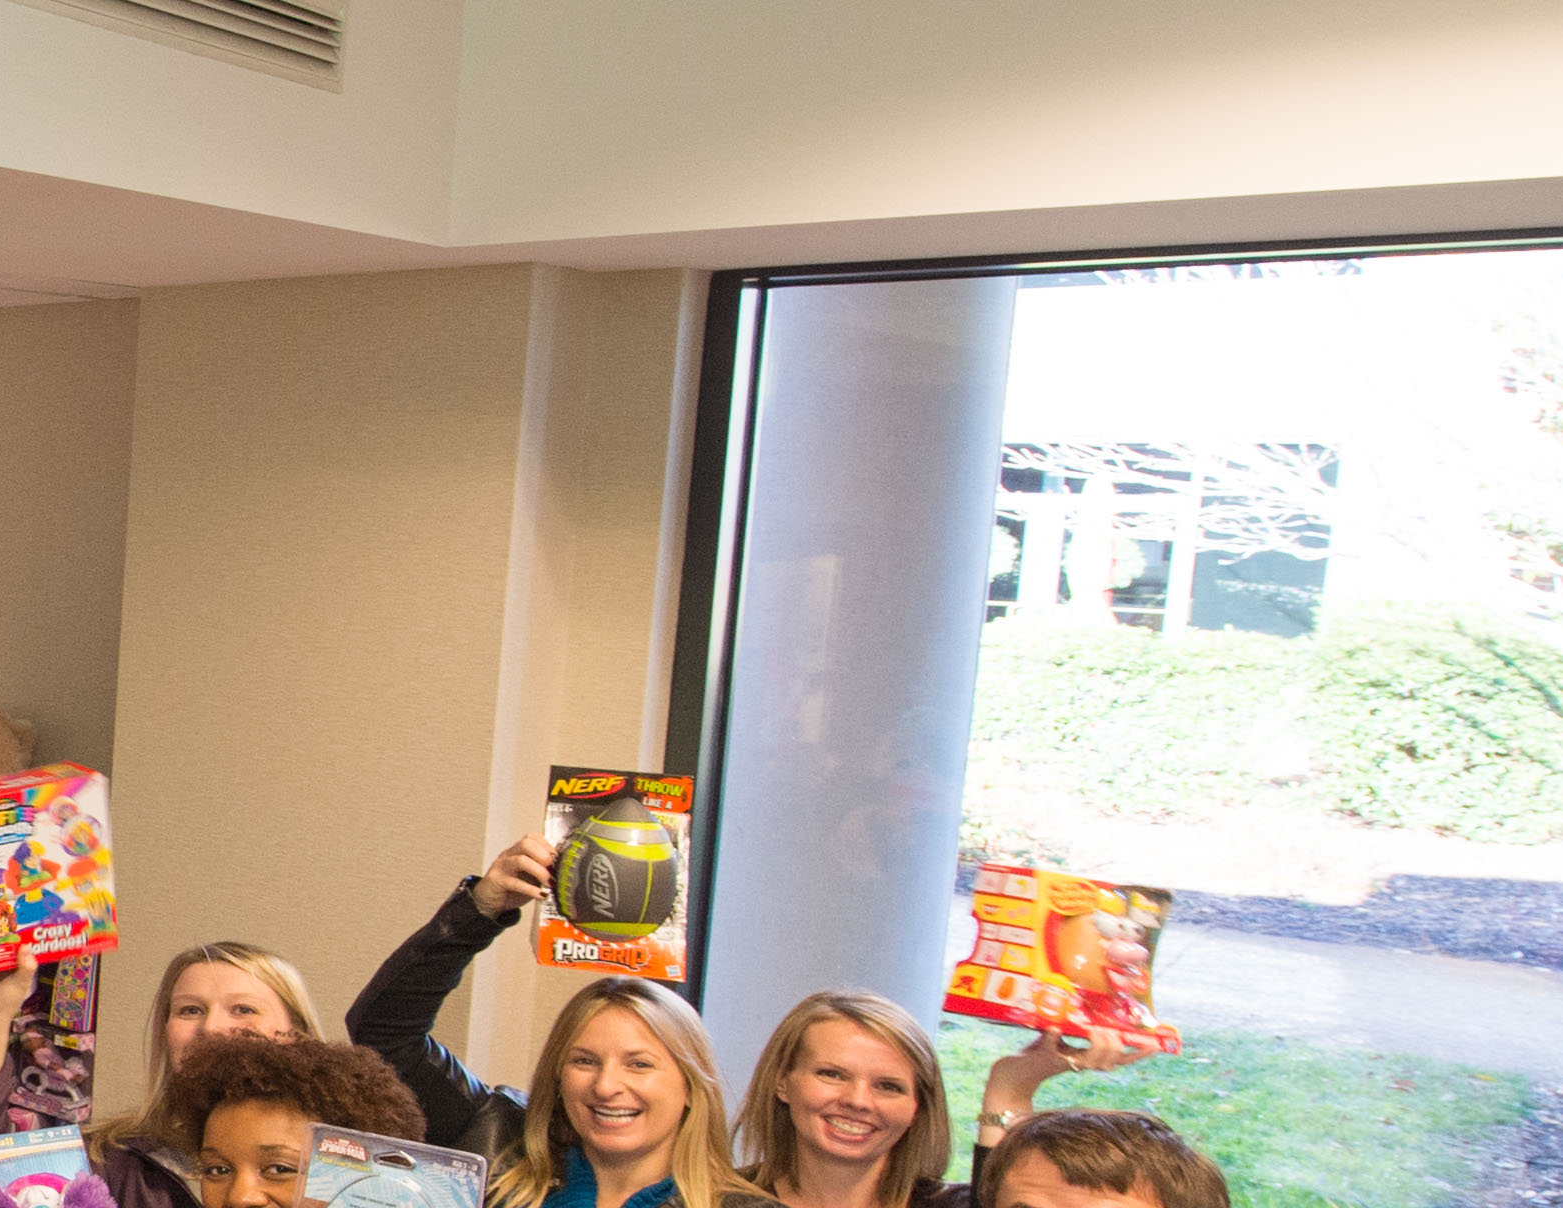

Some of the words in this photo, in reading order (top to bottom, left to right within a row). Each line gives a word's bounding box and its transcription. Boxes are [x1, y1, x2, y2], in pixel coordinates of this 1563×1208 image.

[551, 776, 625, 796] NERF
[637, 778, 684, 797] THROW
[643, 796, 663, 808] LIKE
[664, 800, 673, 809] A
[592, 854, 615, 920] NERF
[34, 923, 72, 941] Crazy
